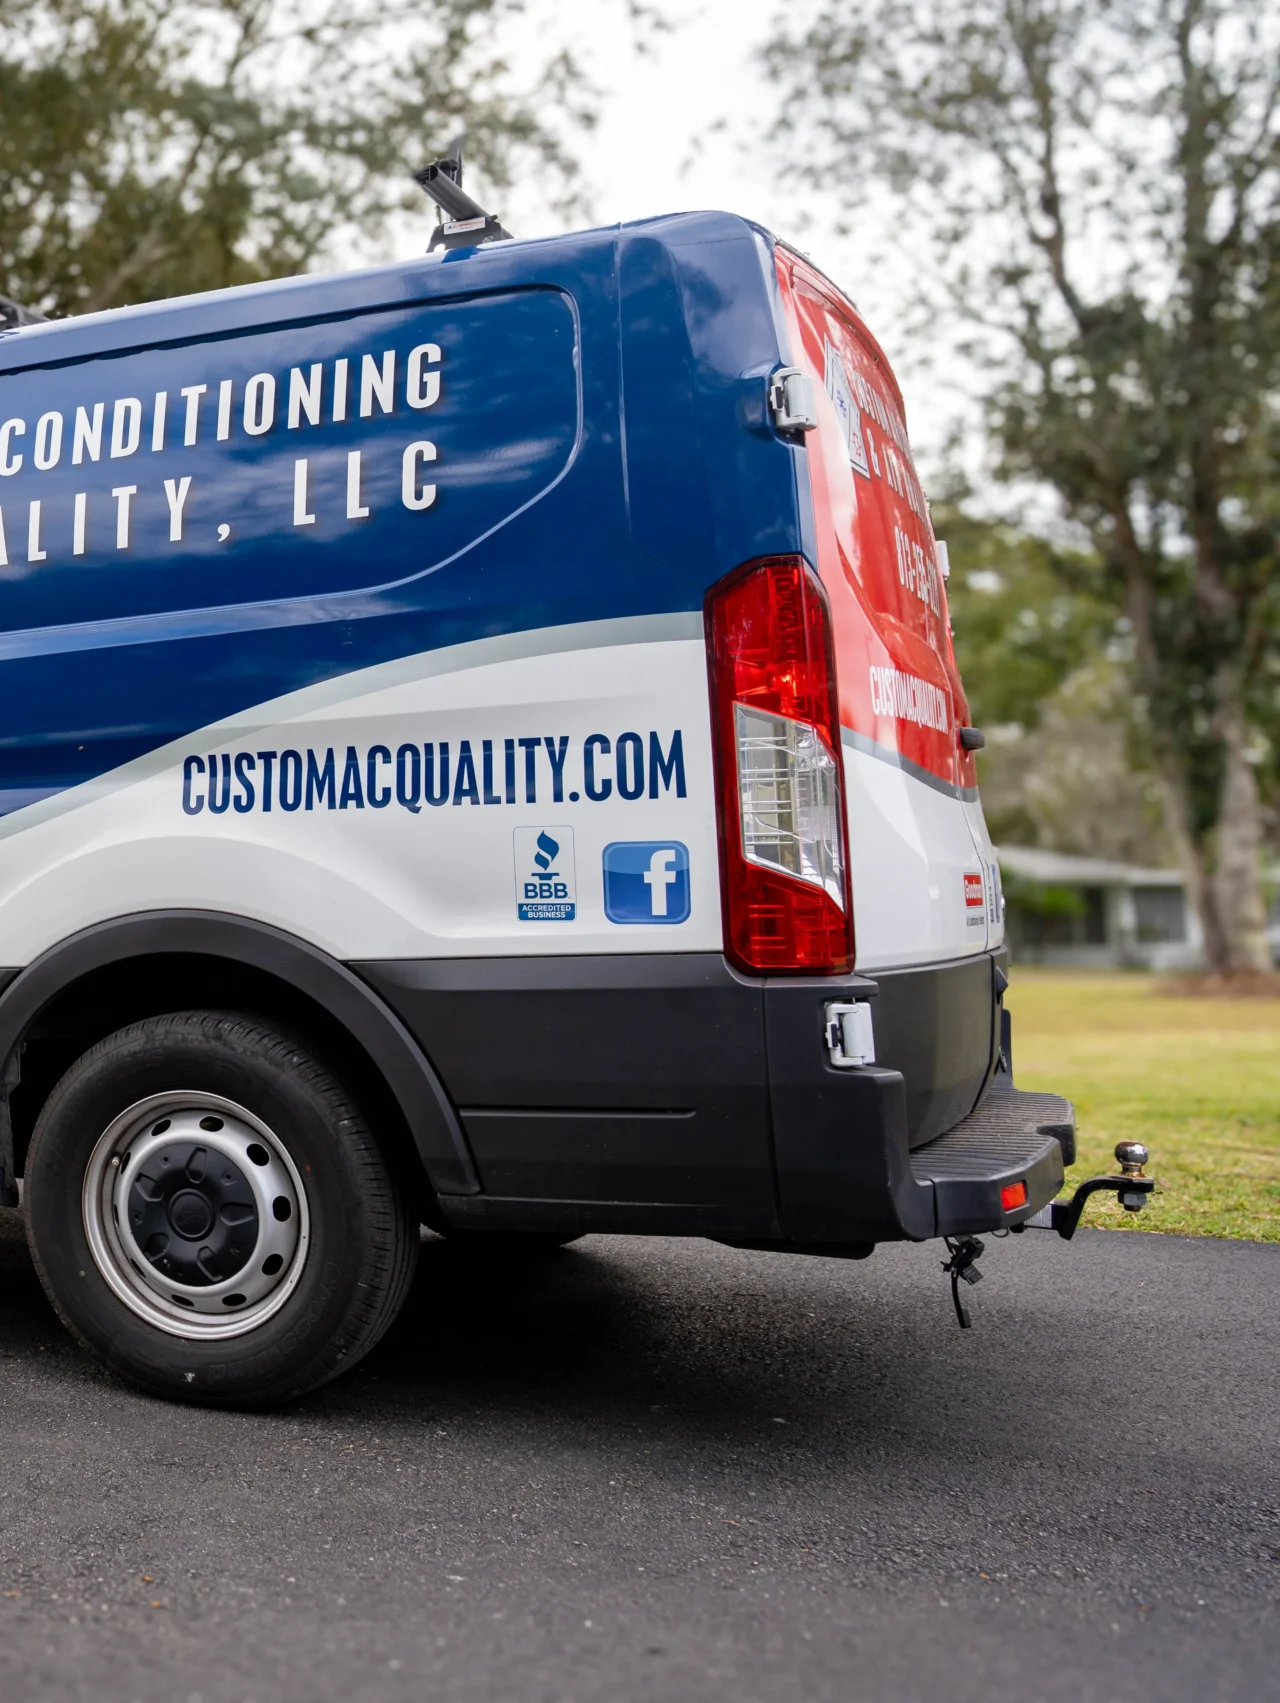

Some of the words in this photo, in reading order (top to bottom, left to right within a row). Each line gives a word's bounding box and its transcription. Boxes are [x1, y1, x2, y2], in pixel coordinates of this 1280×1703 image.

[293, 440, 438, 527] LLC
[182, 729, 689, 816] CUSTOMACQUALITY.COM
[523, 882, 569, 900] BBB
[521, 904, 572, 913] ACCREDITED
[527, 911, 566, 919] BUSINESS
